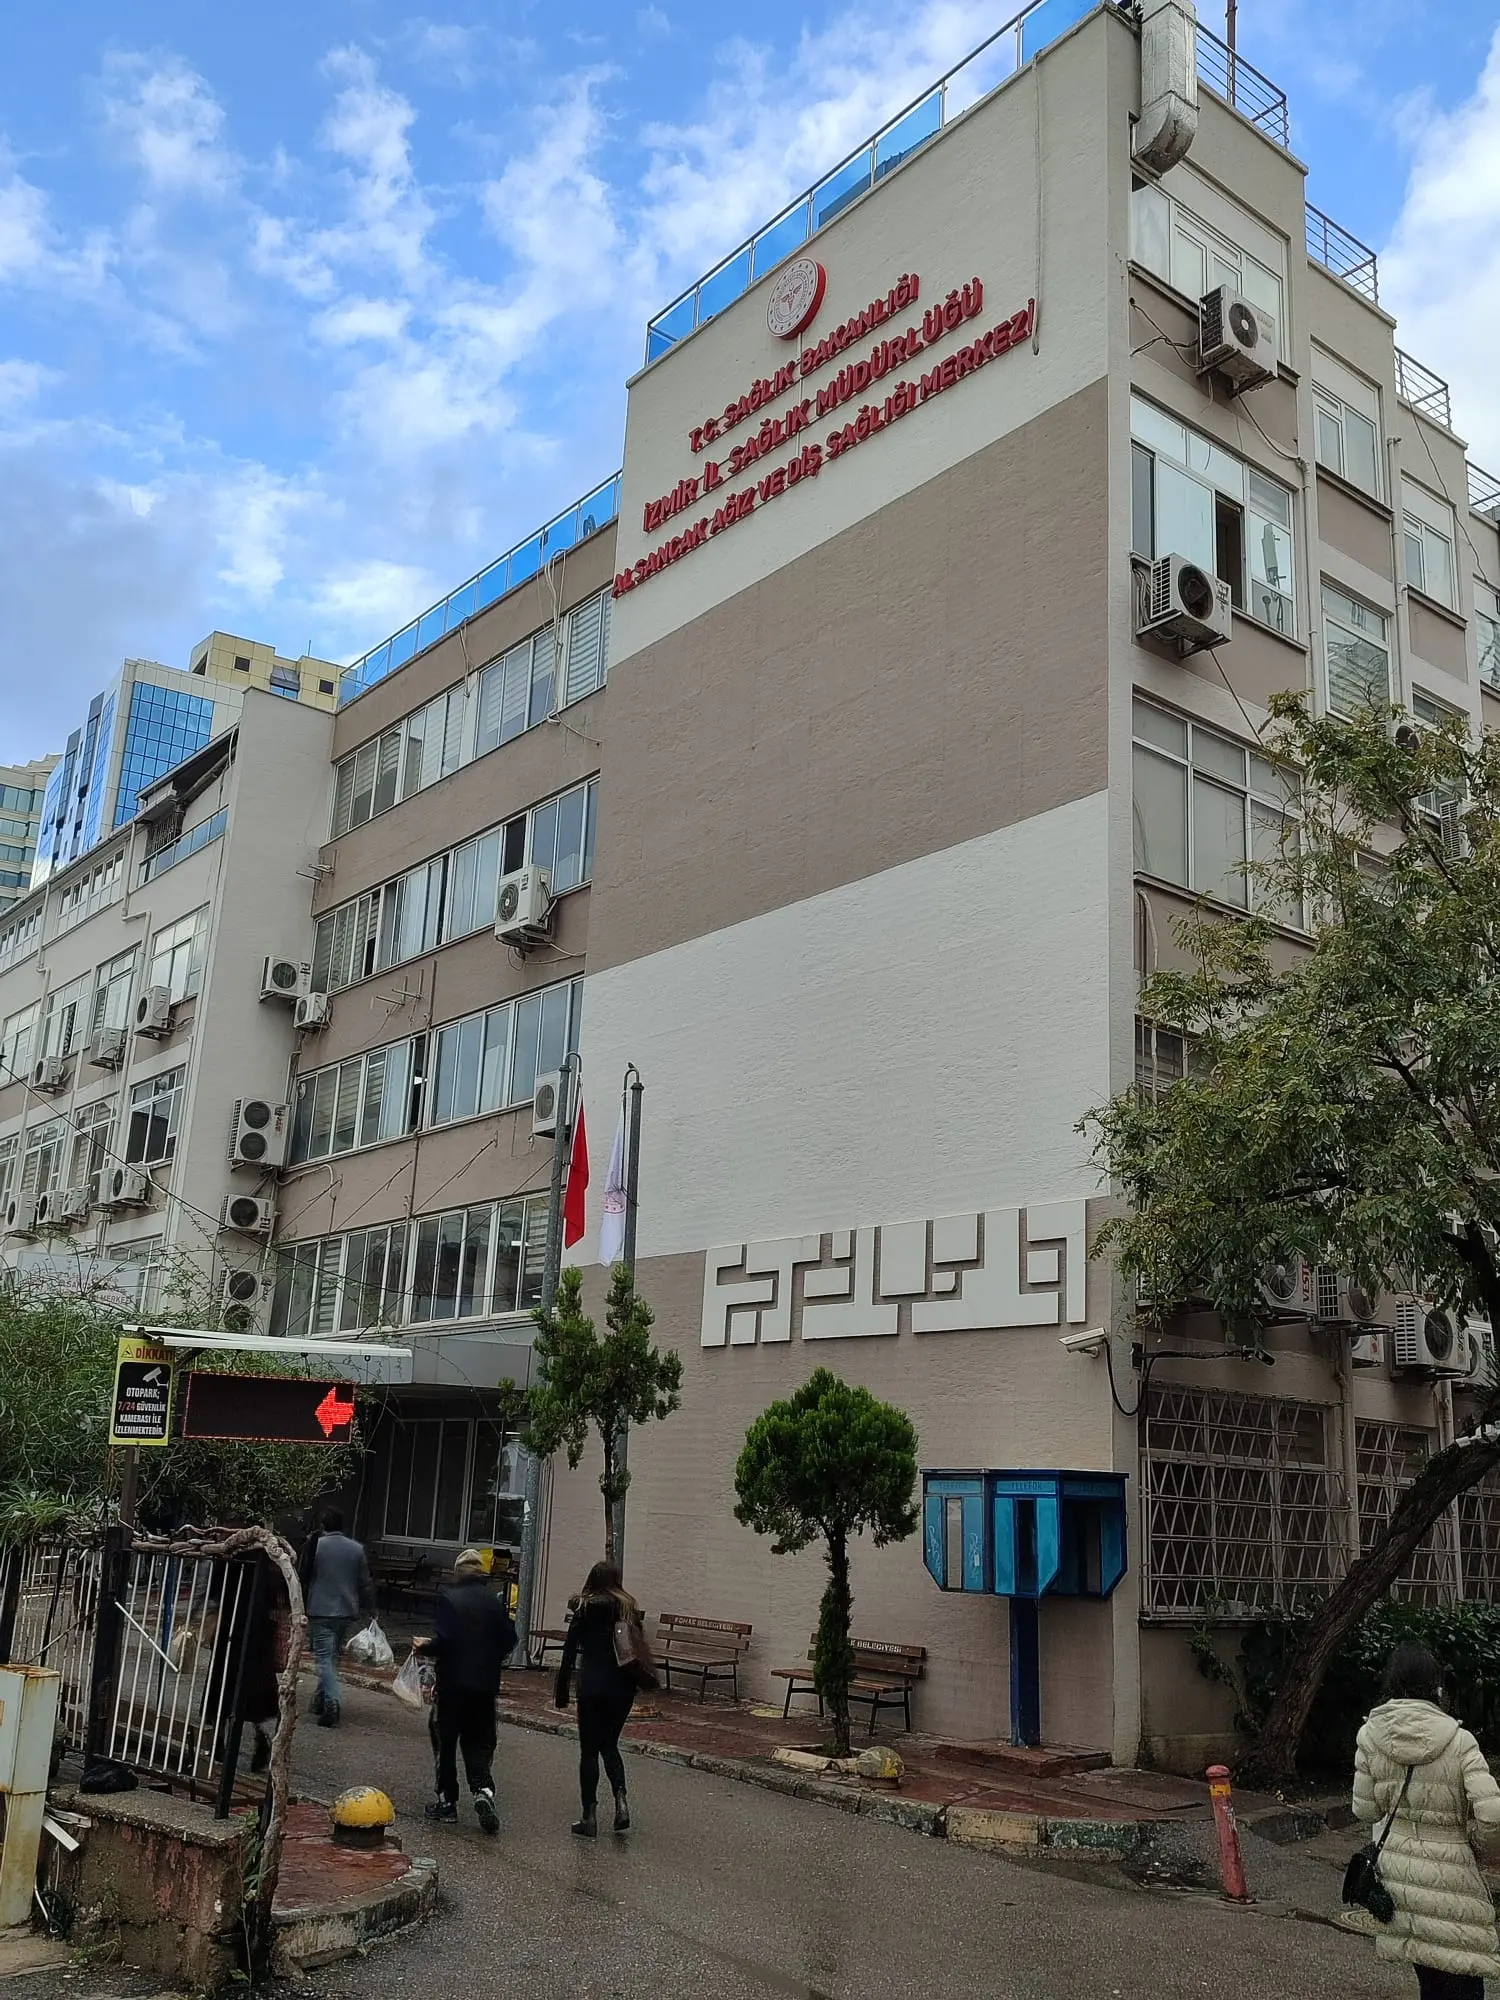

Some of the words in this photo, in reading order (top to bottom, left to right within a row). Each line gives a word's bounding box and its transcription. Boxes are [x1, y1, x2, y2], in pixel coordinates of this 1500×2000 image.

[643, 478, 699, 533] İZMİR
[703, 461, 723, 491] İL
[728, 398, 810, 474] SAĞLIK
[816, 277, 983, 416] MÜDÜRLÜĞÜ
[688, 418, 721, 453] T.C.
[724, 360, 796, 428] SAĞLIK
[800, 273, 919, 376] BAKANLIĞI
[612, 517, 708, 599] ALSANCAK
[710, 487, 756, 535] AĞIZ
[758, 467, 786, 501] VE
[788, 444, 822, 485] DİŞ
[826, 381, 917, 459] SAĞLIĞI
[920, 298, 1035, 400] MERKEZİ
[1301, 1258, 1310, 1302] VESTE
[118, 1401, 136, 1412] 7/24
[136, 1401, 166, 1412] GÜVENLİK
[119, 1414, 151, 1423] KAMERASI
[152, 1413, 162, 1424] İLE
